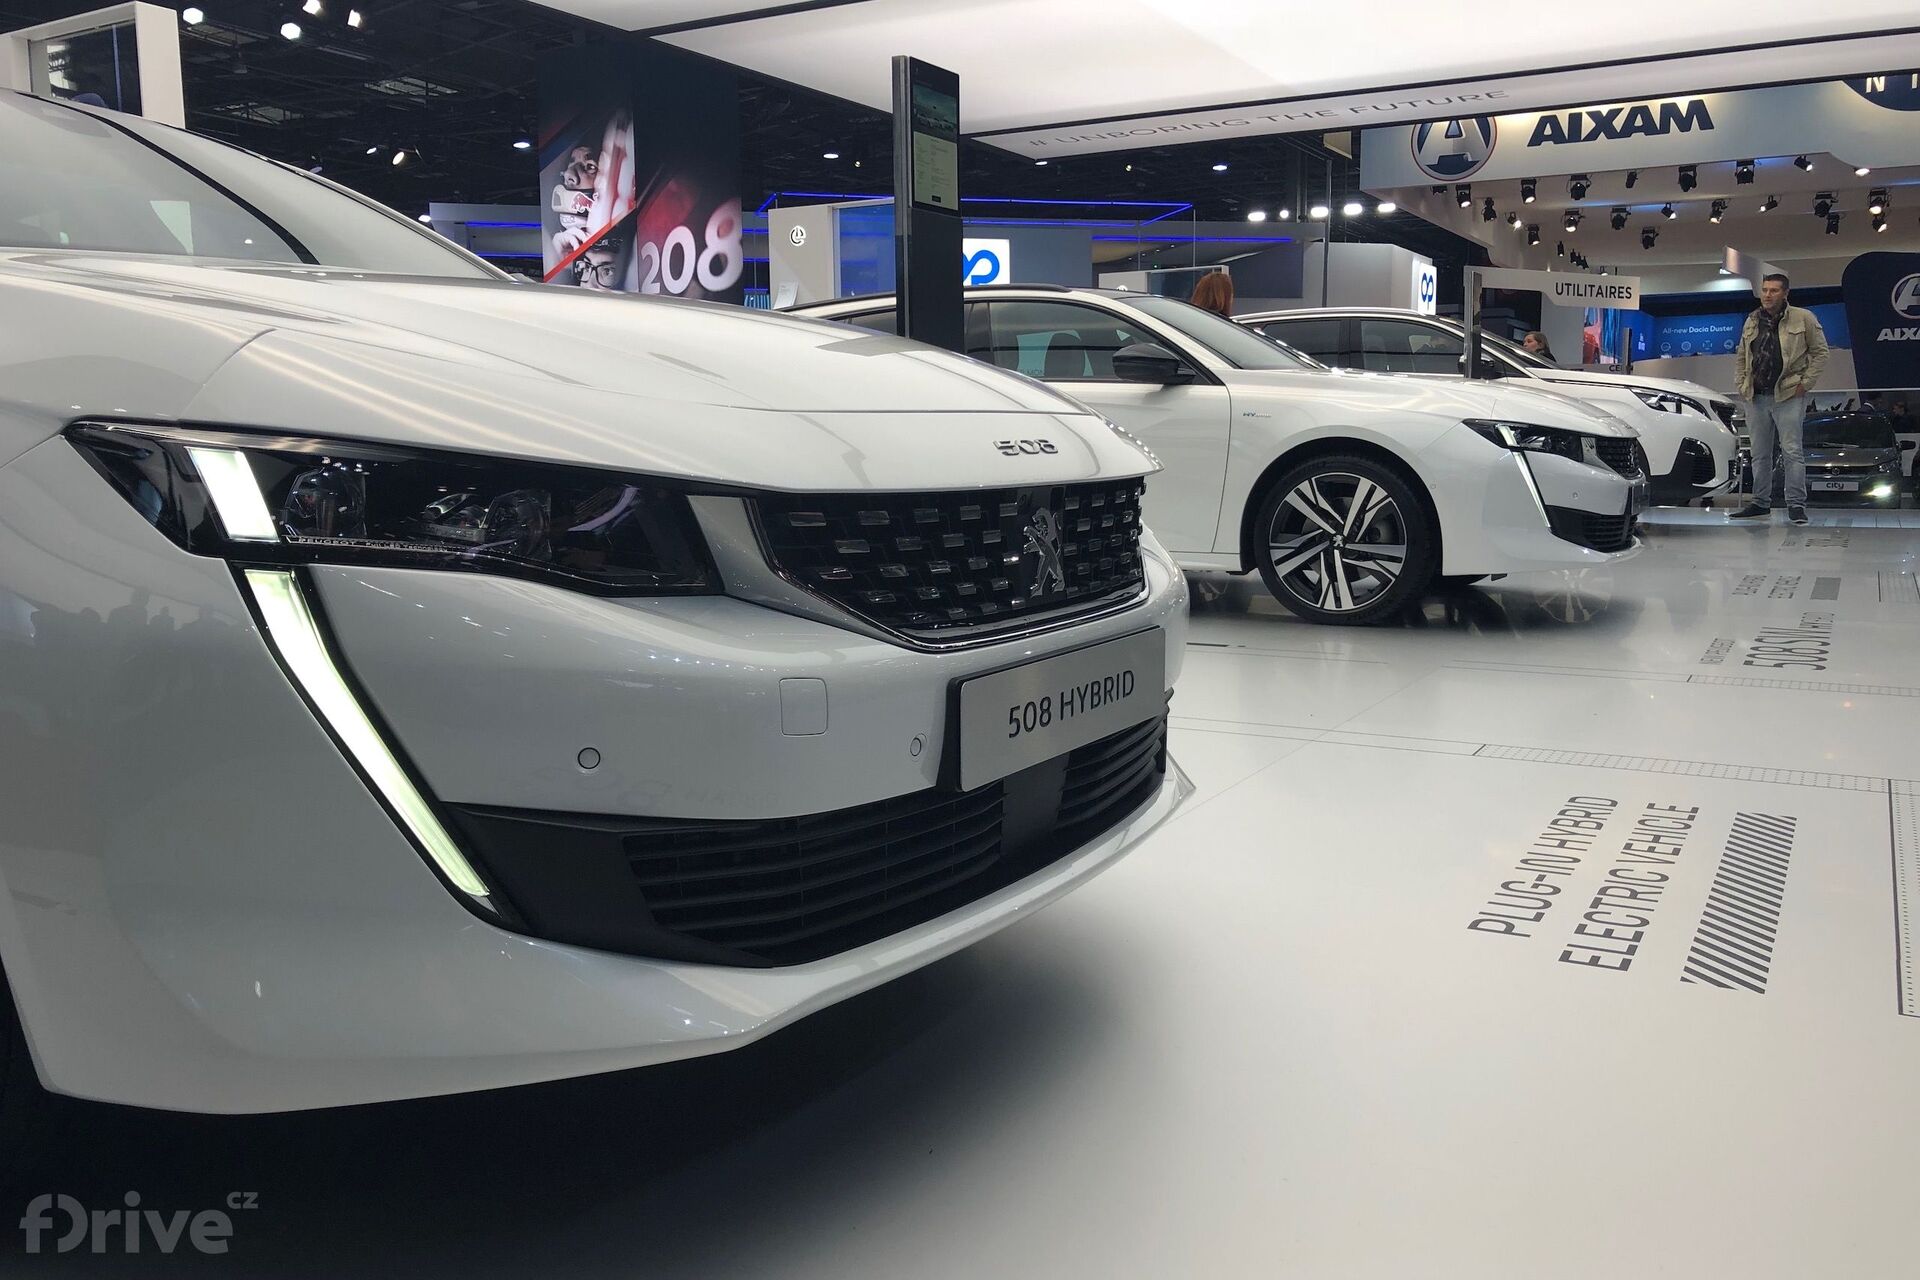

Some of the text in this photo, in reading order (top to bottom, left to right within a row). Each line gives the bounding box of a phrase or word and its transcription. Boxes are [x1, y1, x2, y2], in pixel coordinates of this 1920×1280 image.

[1257, 109, 1339, 123] THE
[1348, 90, 1510, 114] FUTURE
[1526, 98, 1715, 147] AIXAM
[640, 199, 744, 295] 208
[1555, 281, 1633, 300] UTILITAIRES
[1662, 324, 1734, 335] All-new Dacia Duster
[992, 439, 1059, 456] 508
[1825, 482, 1845, 490] city
[1008, 669, 1135, 739] 508 HYBRID
[1467, 796, 1619, 939] PLUG-IN HYBRID
[1558, 802, 1700, 972] ELECTRIC VEHICLE
